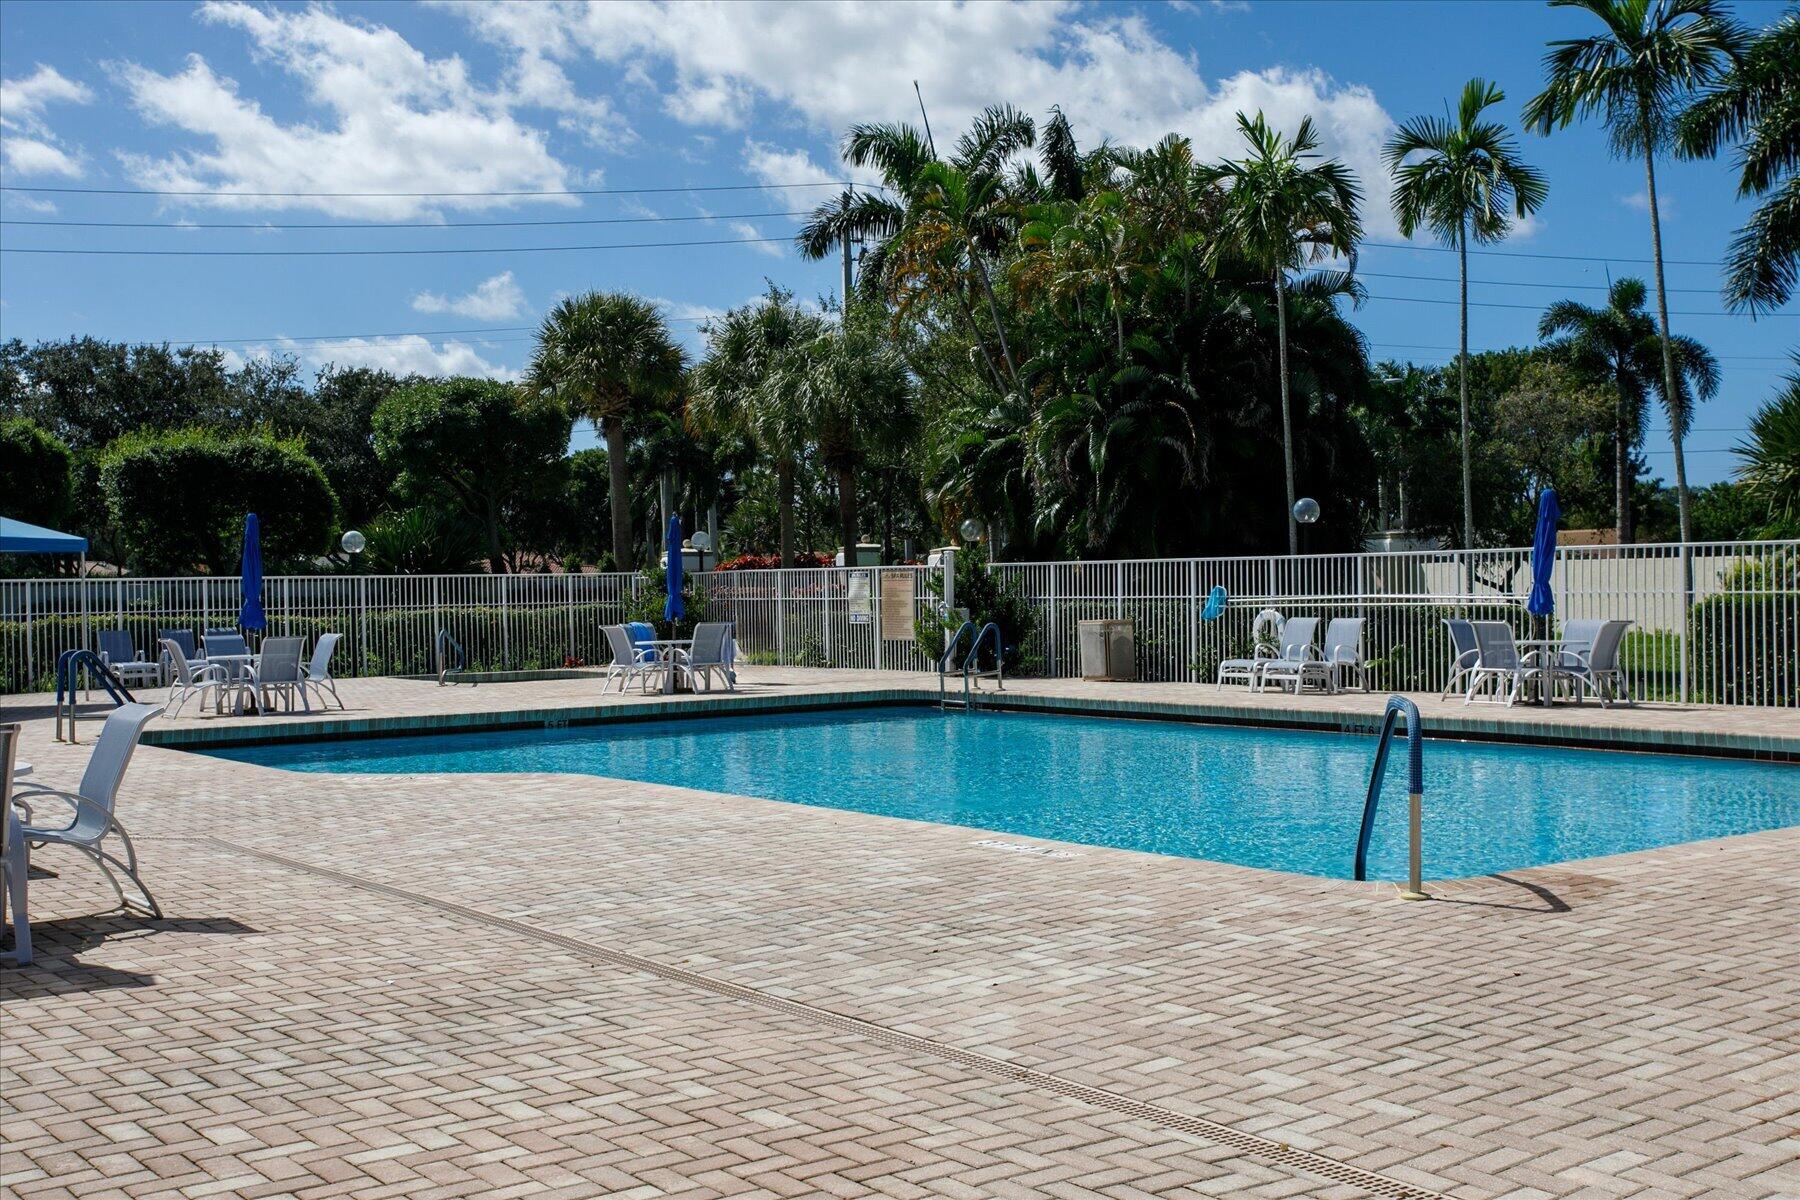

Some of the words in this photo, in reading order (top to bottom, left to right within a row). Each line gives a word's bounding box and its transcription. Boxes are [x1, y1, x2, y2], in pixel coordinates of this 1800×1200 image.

[1344, 724, 1350, 733] 4
[1355, 725, 1365, 734] FT
[1368, 725, 1375, 734] 6
